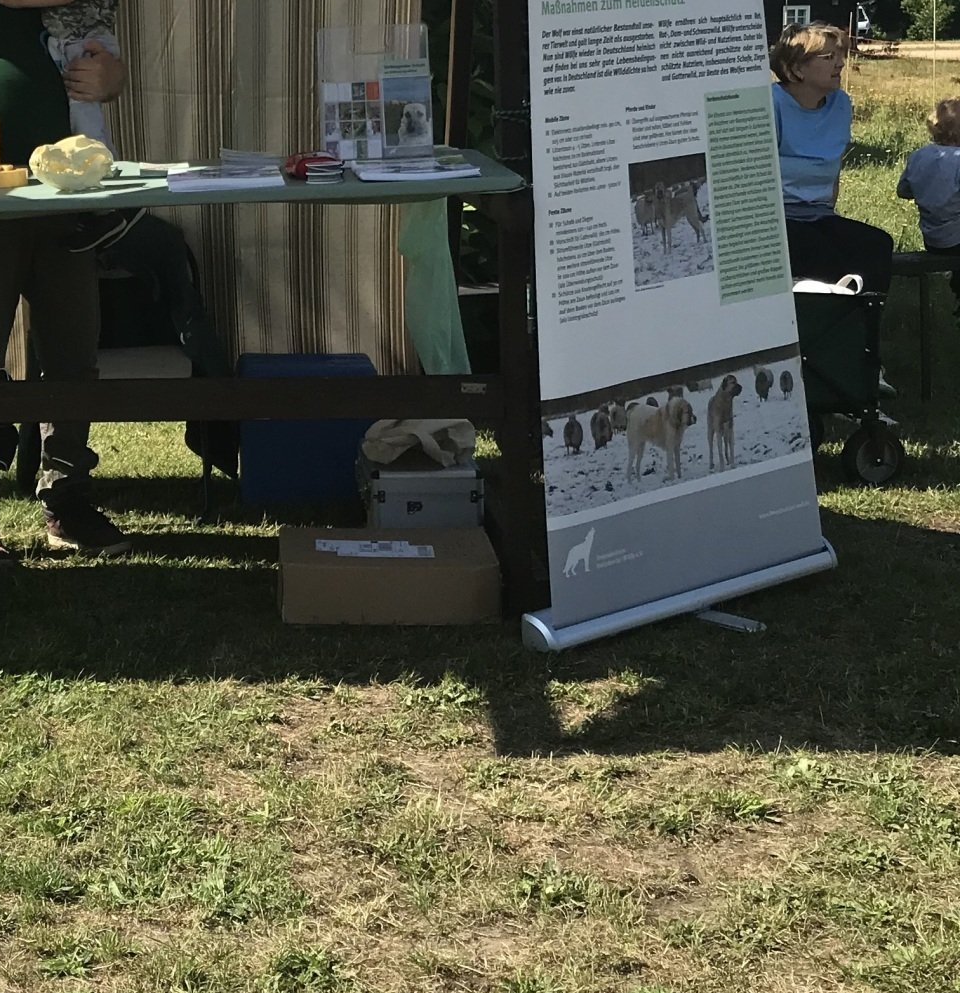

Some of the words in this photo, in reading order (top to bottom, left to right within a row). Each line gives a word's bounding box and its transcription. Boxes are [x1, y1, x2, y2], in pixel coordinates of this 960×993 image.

[658, 19, 672, 28] Wölfe
[684, 28, 692, 36] und
[722, 25, 734, 33] Wölfe
[542, 30, 551, 38] Der
[552, 28, 562, 38] Wolf
[550, 40, 568, 49] Tierwelt
[569, 39, 577, 47] und
[578, 38, 587, 48] galt
[588, 38, 602, 46] lange
[603, 36, 613, 44] Zeit
[614, 34, 622, 43] als
[673, 40, 695, 48] zwischen
[708, 37, 716, 45] und
[579, 49, 595, 57] wieder
[603, 44, 635, 55] Deutschland
[543, 64, 553, 72] und
[554, 63, 569, 73] finden
[589, 59, 600, 68] sehr
[602, 58, 614, 68] gute
[661, 62, 681, 71] schützte
[705, 56, 735, 66] insbesondere
[543, 77, 553, 86] gen
[568, 71, 596, 81] Deutschland
[604, 69, 612, 77] die
[613, 66, 640, 76] Wilddichte
[647, 64, 657, 72] hoch
[662, 74, 671, 82] und
[730, 66, 745, 74] Wolfes
